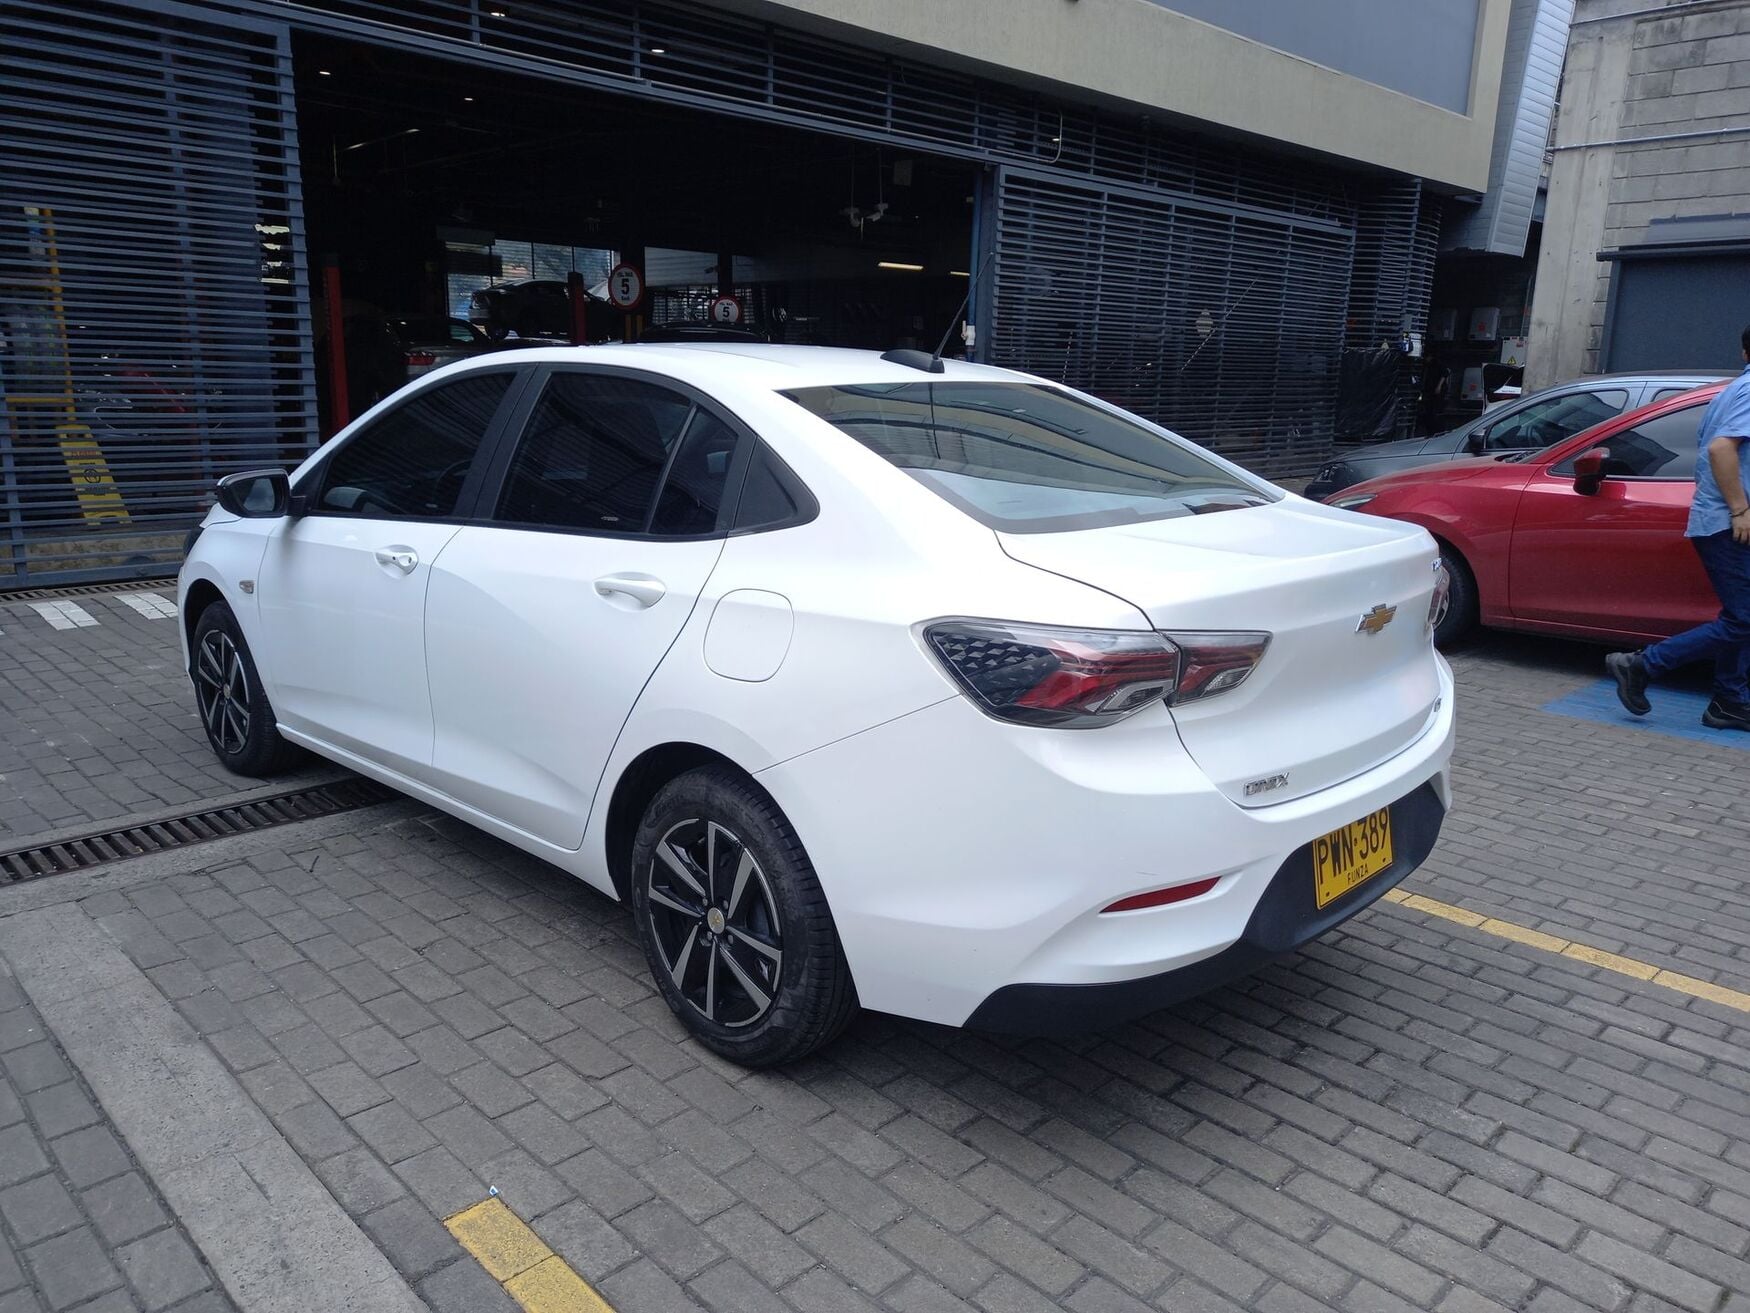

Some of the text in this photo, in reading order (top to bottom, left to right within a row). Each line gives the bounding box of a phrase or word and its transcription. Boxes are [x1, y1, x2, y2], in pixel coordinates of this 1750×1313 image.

[621, 278, 630, 295] 5
[722, 306, 730, 318] 5
[1347, 863, 1369, 885] FUNZA
